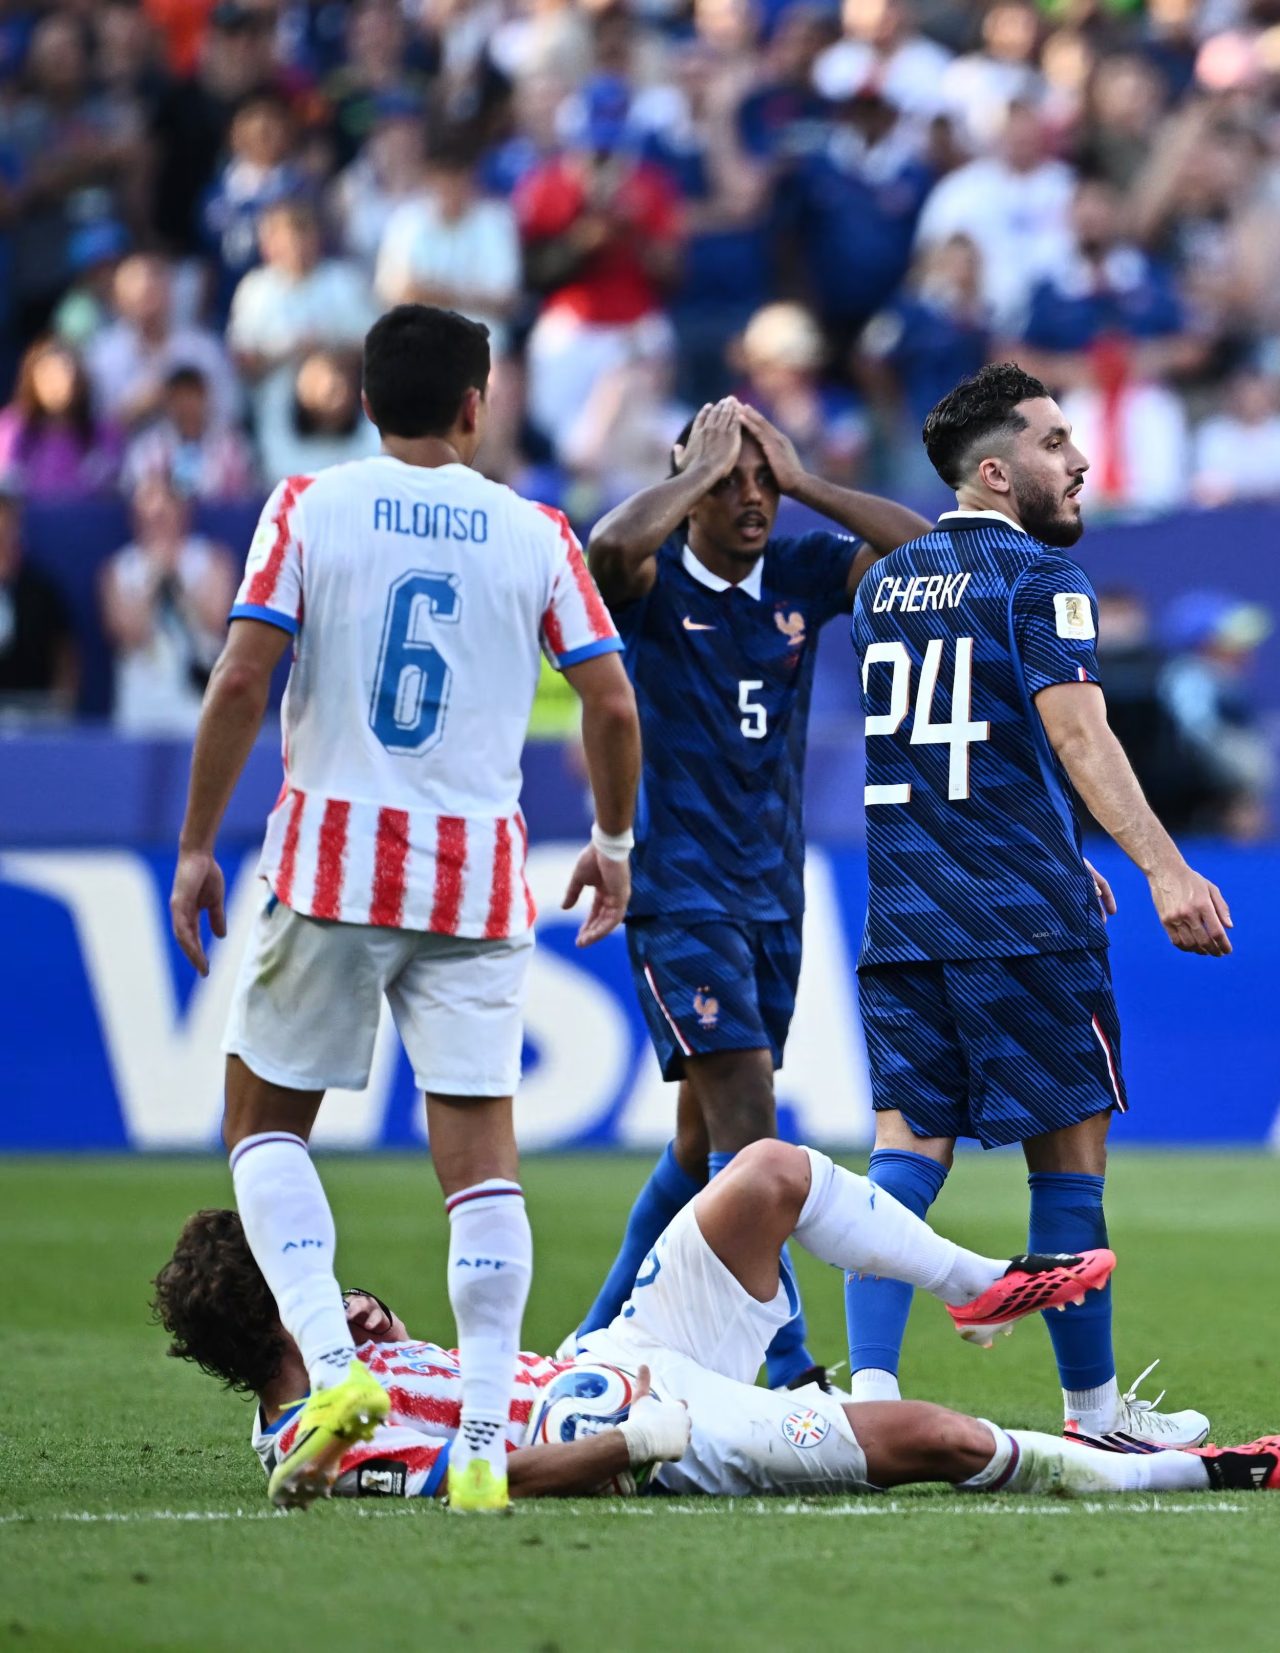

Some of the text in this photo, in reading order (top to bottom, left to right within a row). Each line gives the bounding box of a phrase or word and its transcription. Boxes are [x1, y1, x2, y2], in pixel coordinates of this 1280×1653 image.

[374, 498, 488, 543] ALONSO
[872, 572, 972, 614] CHERKI
[368, 568, 462, 758] 6
[737, 679, 768, 739] 5
[861, 636, 991, 806] 24
[0, 845, 876, 1148] VSA
